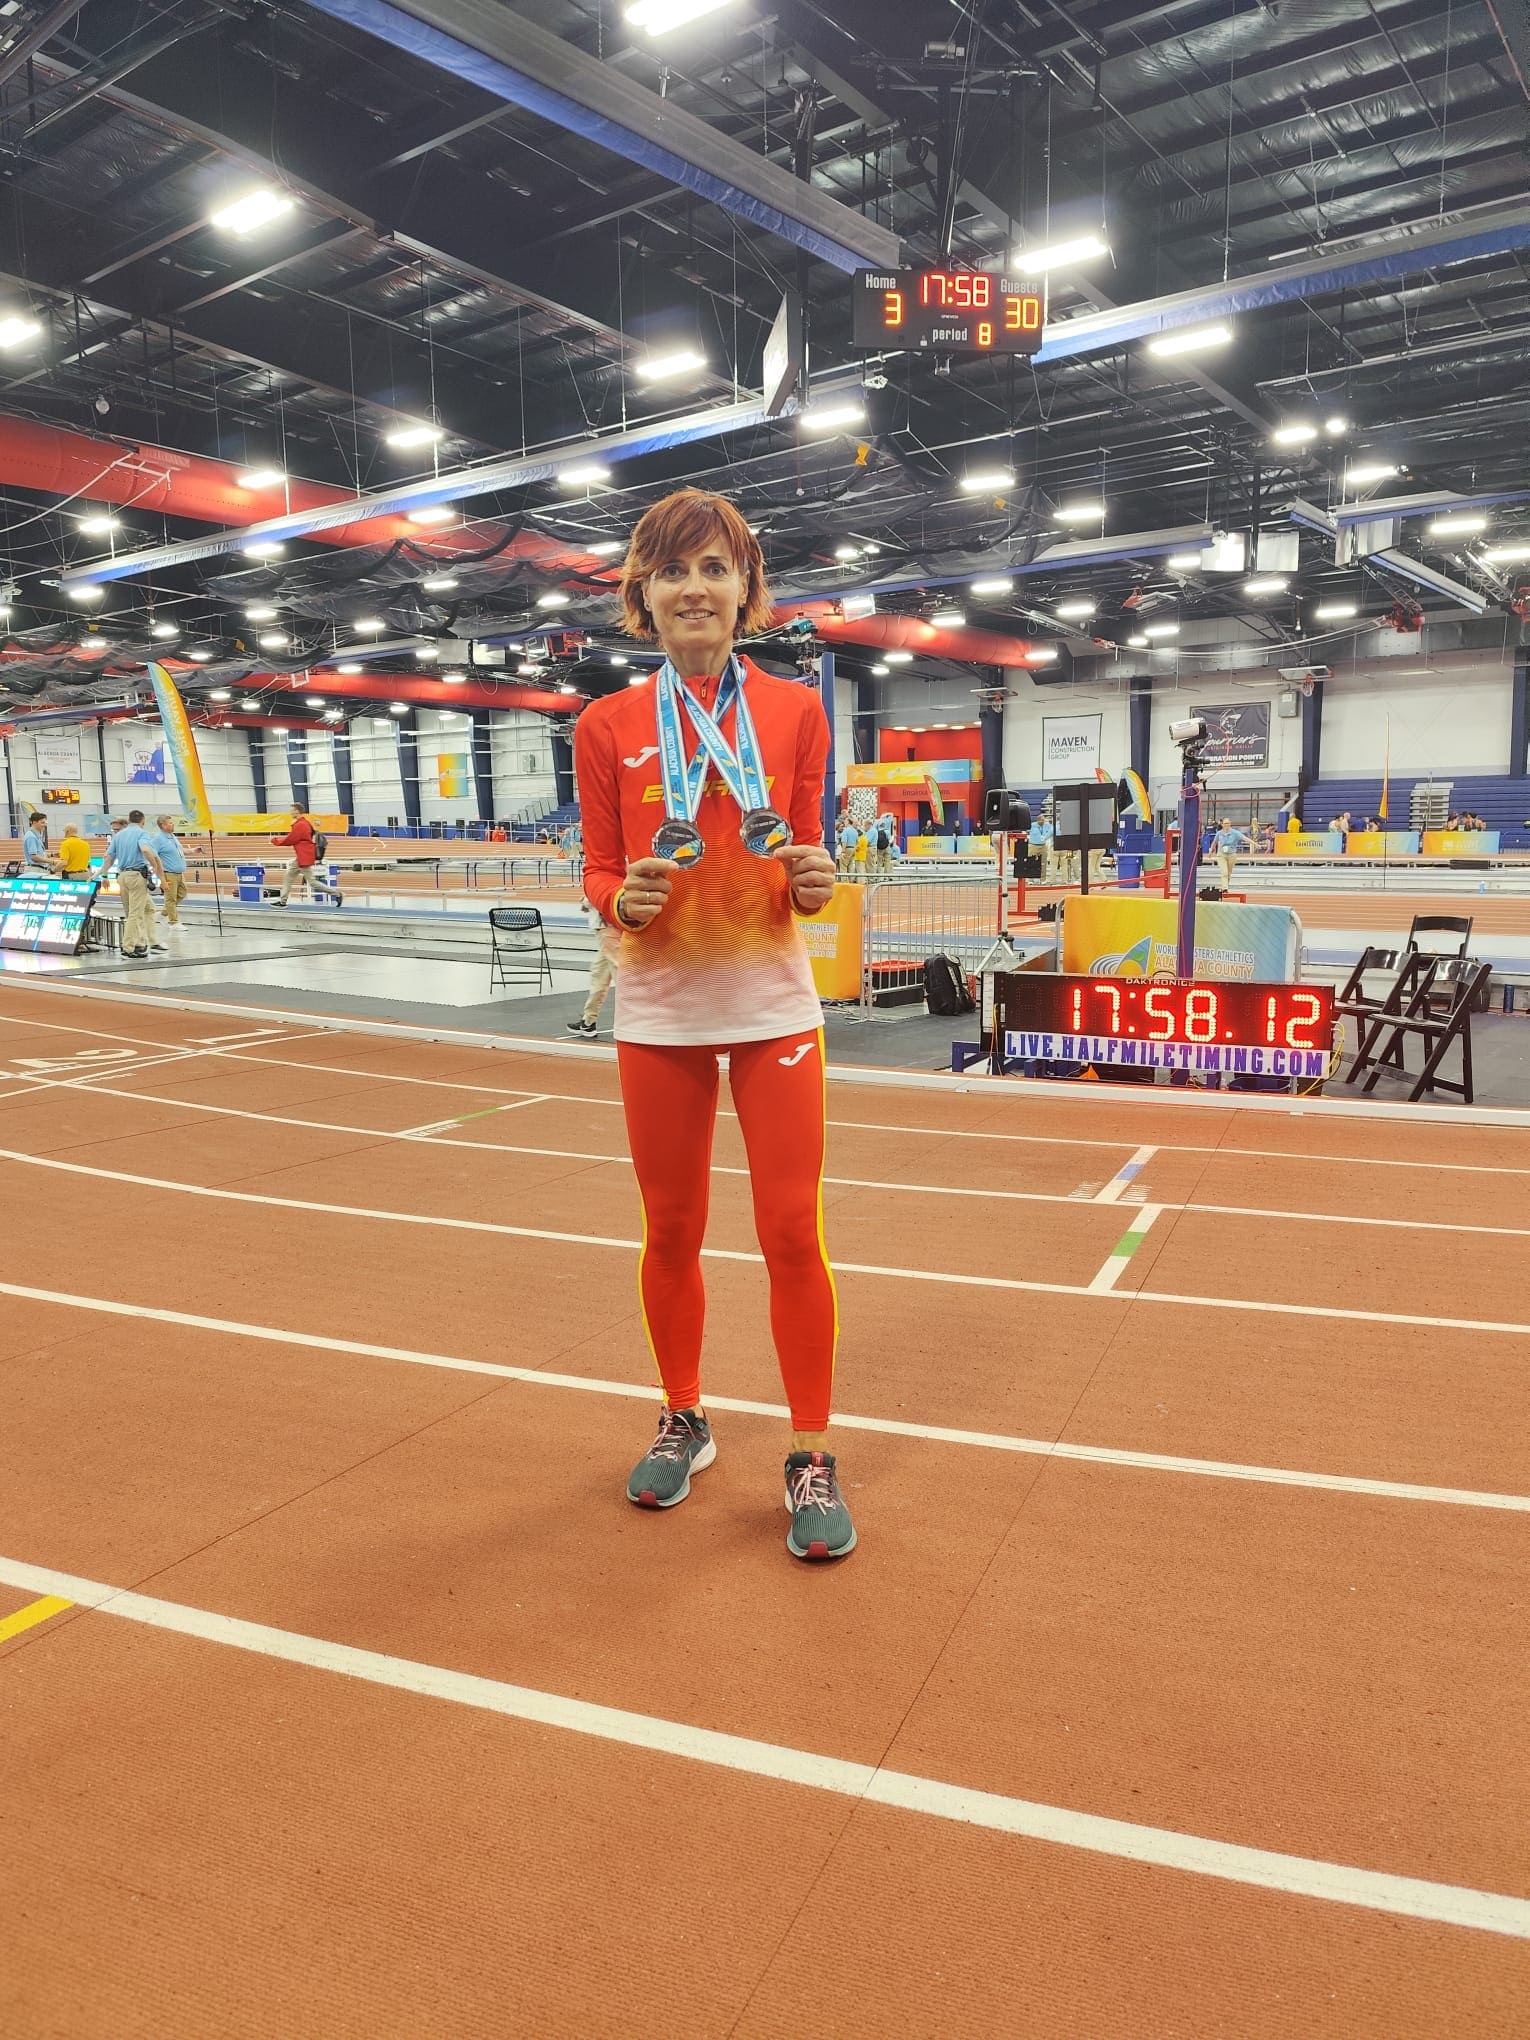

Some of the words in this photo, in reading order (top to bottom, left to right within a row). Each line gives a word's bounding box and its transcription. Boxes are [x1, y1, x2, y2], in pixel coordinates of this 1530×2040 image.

[865, 274, 897, 289] Home
[1000, 279, 1038, 294] Guests
[922, 274, 990, 308] 17:58
[884, 292, 902, 326] 3
[1005, 297, 1040, 329] 30
[932, 327, 968, 342] period
[978, 322, 992, 346] 8
[1051, 736, 1088, 747] MAVEN
[1050, 746, 1095, 754] CONSTRUCTION
[1216, 951, 1255, 964] ATHLETICS
[1207, 962, 1255, 978] COUNTY
[1006, 1032, 1323, 1077] LIVE.HALFMILETIMING.COM
